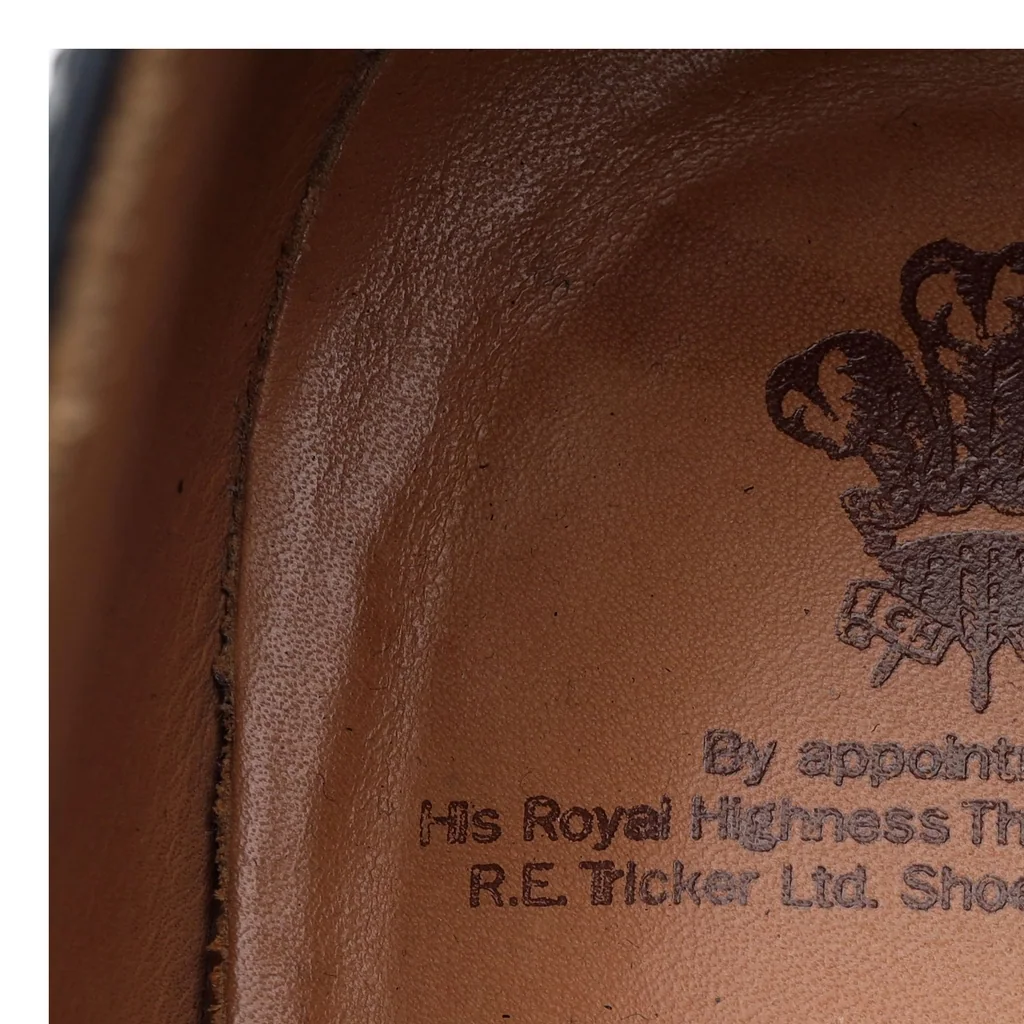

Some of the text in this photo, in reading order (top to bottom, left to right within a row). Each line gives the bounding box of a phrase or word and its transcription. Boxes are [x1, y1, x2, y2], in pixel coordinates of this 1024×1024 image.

[702, 729, 777, 786] By
[419, 799, 502, 847] His
[523, 796, 673, 850] Royal
[690, 796, 951, 852] Highness
[468, 862, 568, 909] R.E.
[578, 860, 760, 906] Tricker
[781, 862, 879, 910] Ltd.
